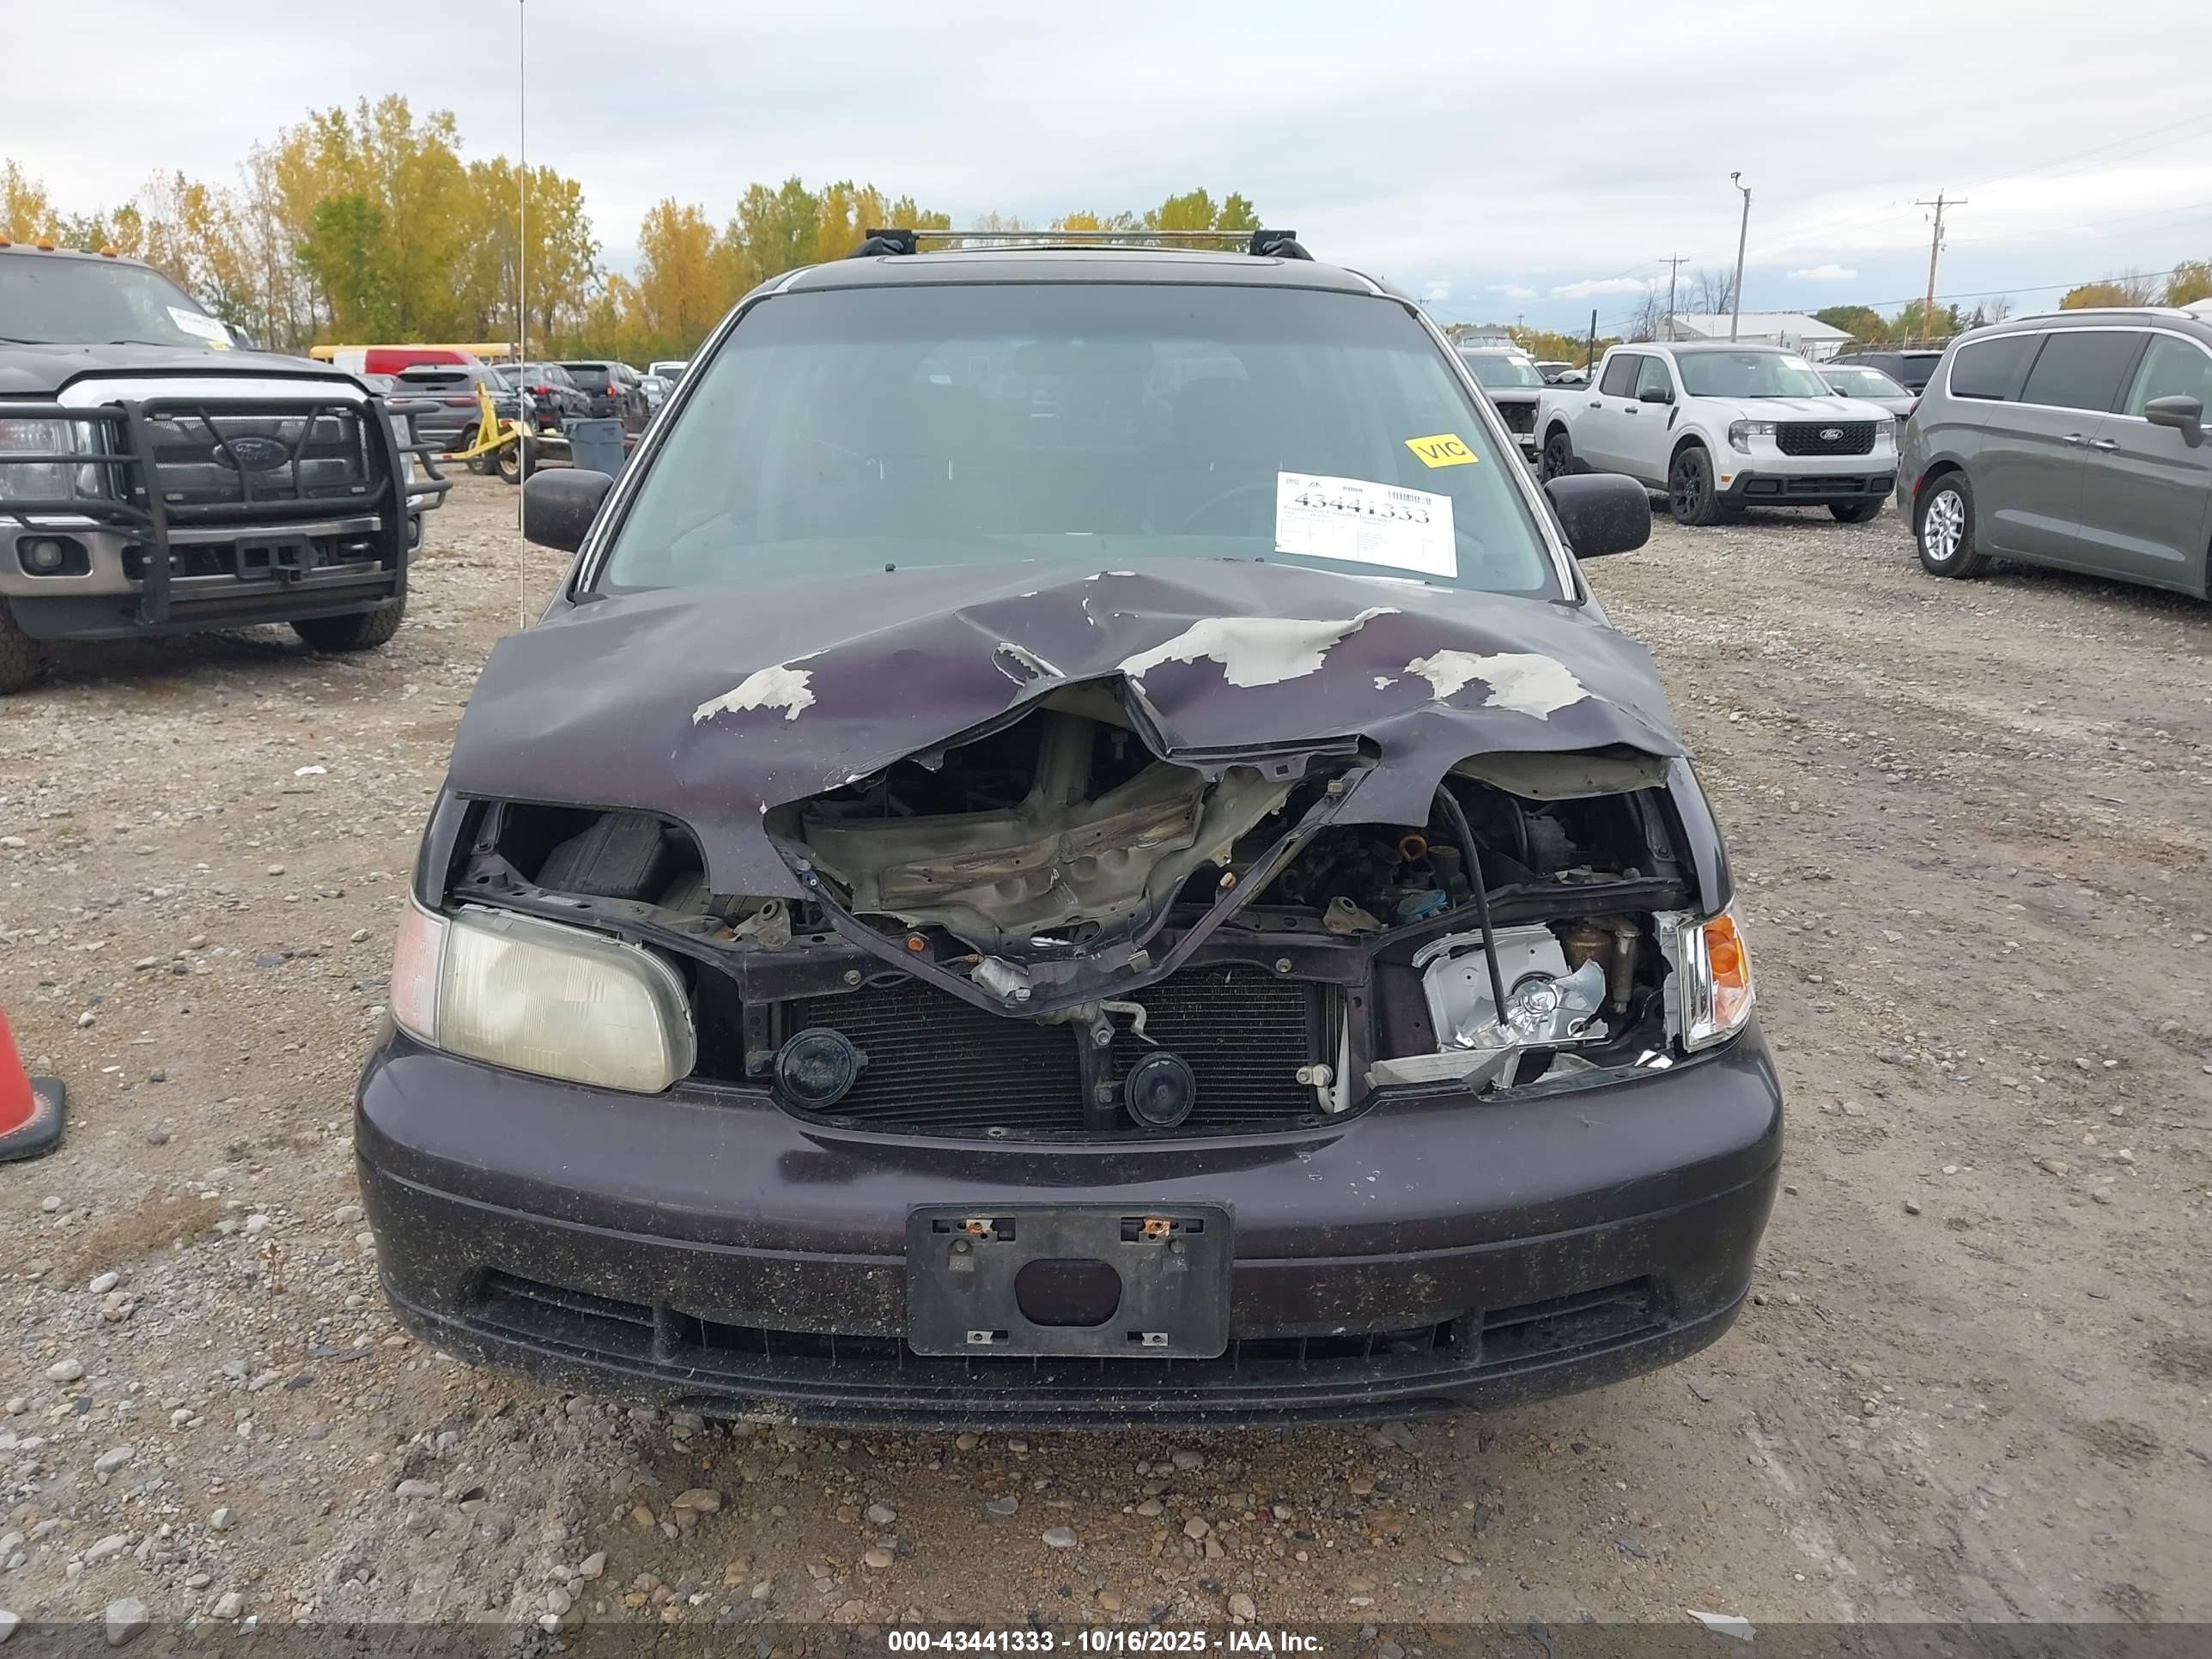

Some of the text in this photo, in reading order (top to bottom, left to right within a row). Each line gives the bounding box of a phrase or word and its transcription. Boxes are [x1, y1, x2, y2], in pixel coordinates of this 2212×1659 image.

[235, 443, 271, 462] Ford
[1417, 441, 1466, 459] VIC
[1294, 492, 1430, 524] 43441333
